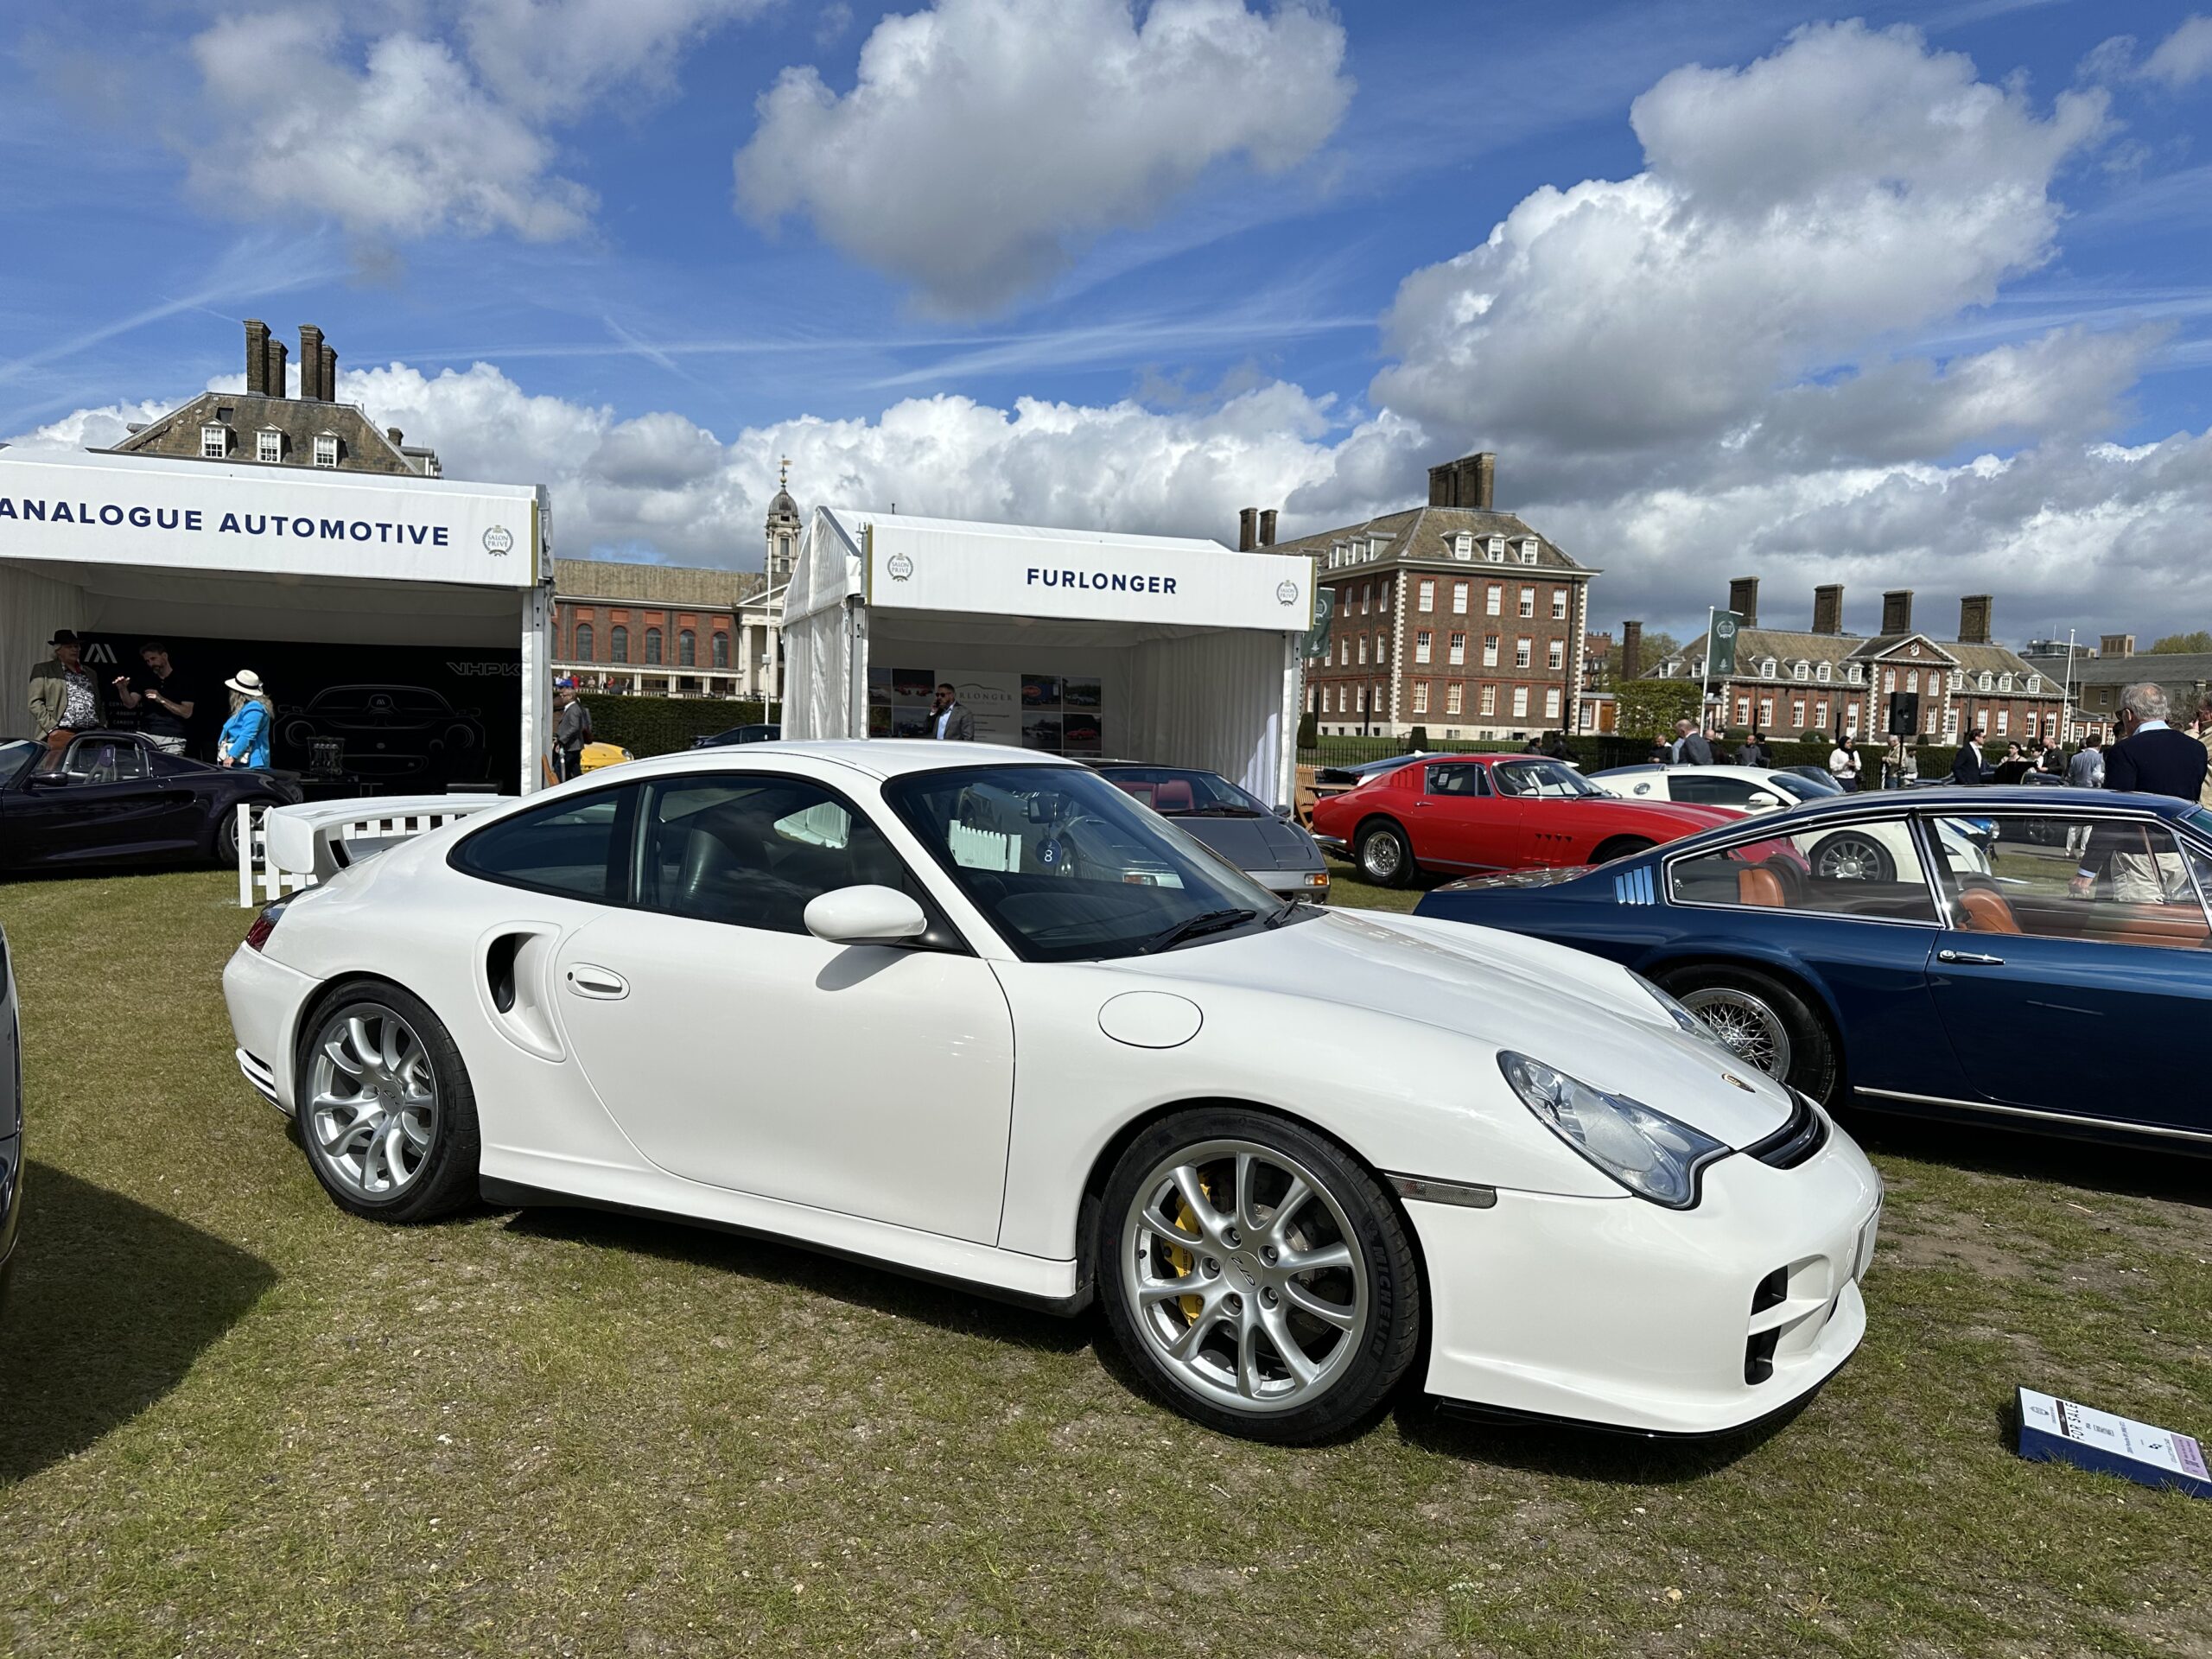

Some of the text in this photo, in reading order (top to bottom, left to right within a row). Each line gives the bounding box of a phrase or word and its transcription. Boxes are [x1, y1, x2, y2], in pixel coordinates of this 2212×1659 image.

[0, 498, 448, 546] ANALOGUE AUTOMOTIVE
[1027, 568, 1177, 594] FURLONGER
[955, 692, 1012, 701] RLONGER
[1045, 849, 1053, 862] 8
[1231, 1256, 1255, 1286] GT2
[1372, 1246, 1392, 1357] MICHELIN
[2064, 1402, 2085, 1442] FOR SALE
